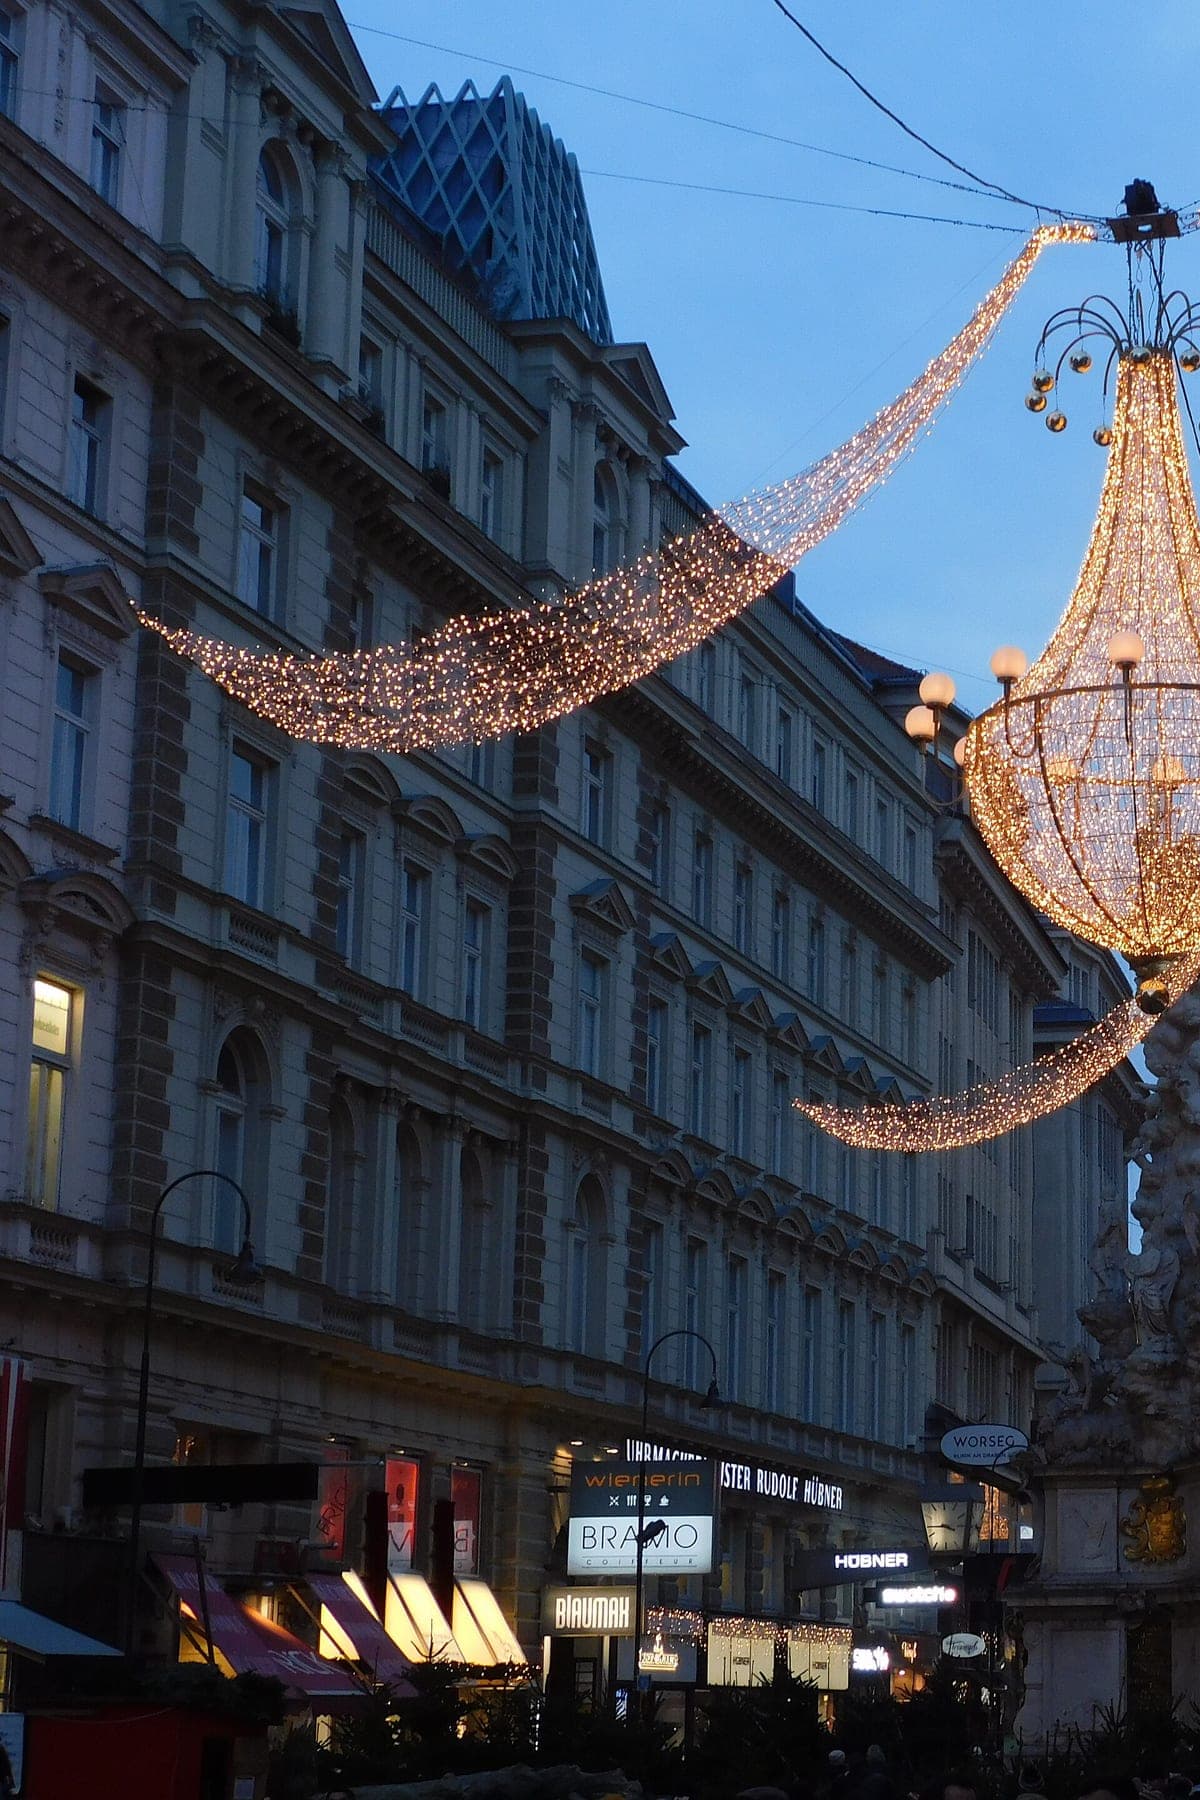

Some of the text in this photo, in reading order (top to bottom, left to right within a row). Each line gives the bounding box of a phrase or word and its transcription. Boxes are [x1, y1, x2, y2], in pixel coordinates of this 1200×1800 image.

[953, 1435, 1015, 1448] WORSEG
[584, 1471, 701, 1488] wienerin
[756, 1470, 799, 1500] RUDOLF
[803, 1475, 843, 1510] HÜBNER
[834, 1552, 909, 1569] HÜBNER
